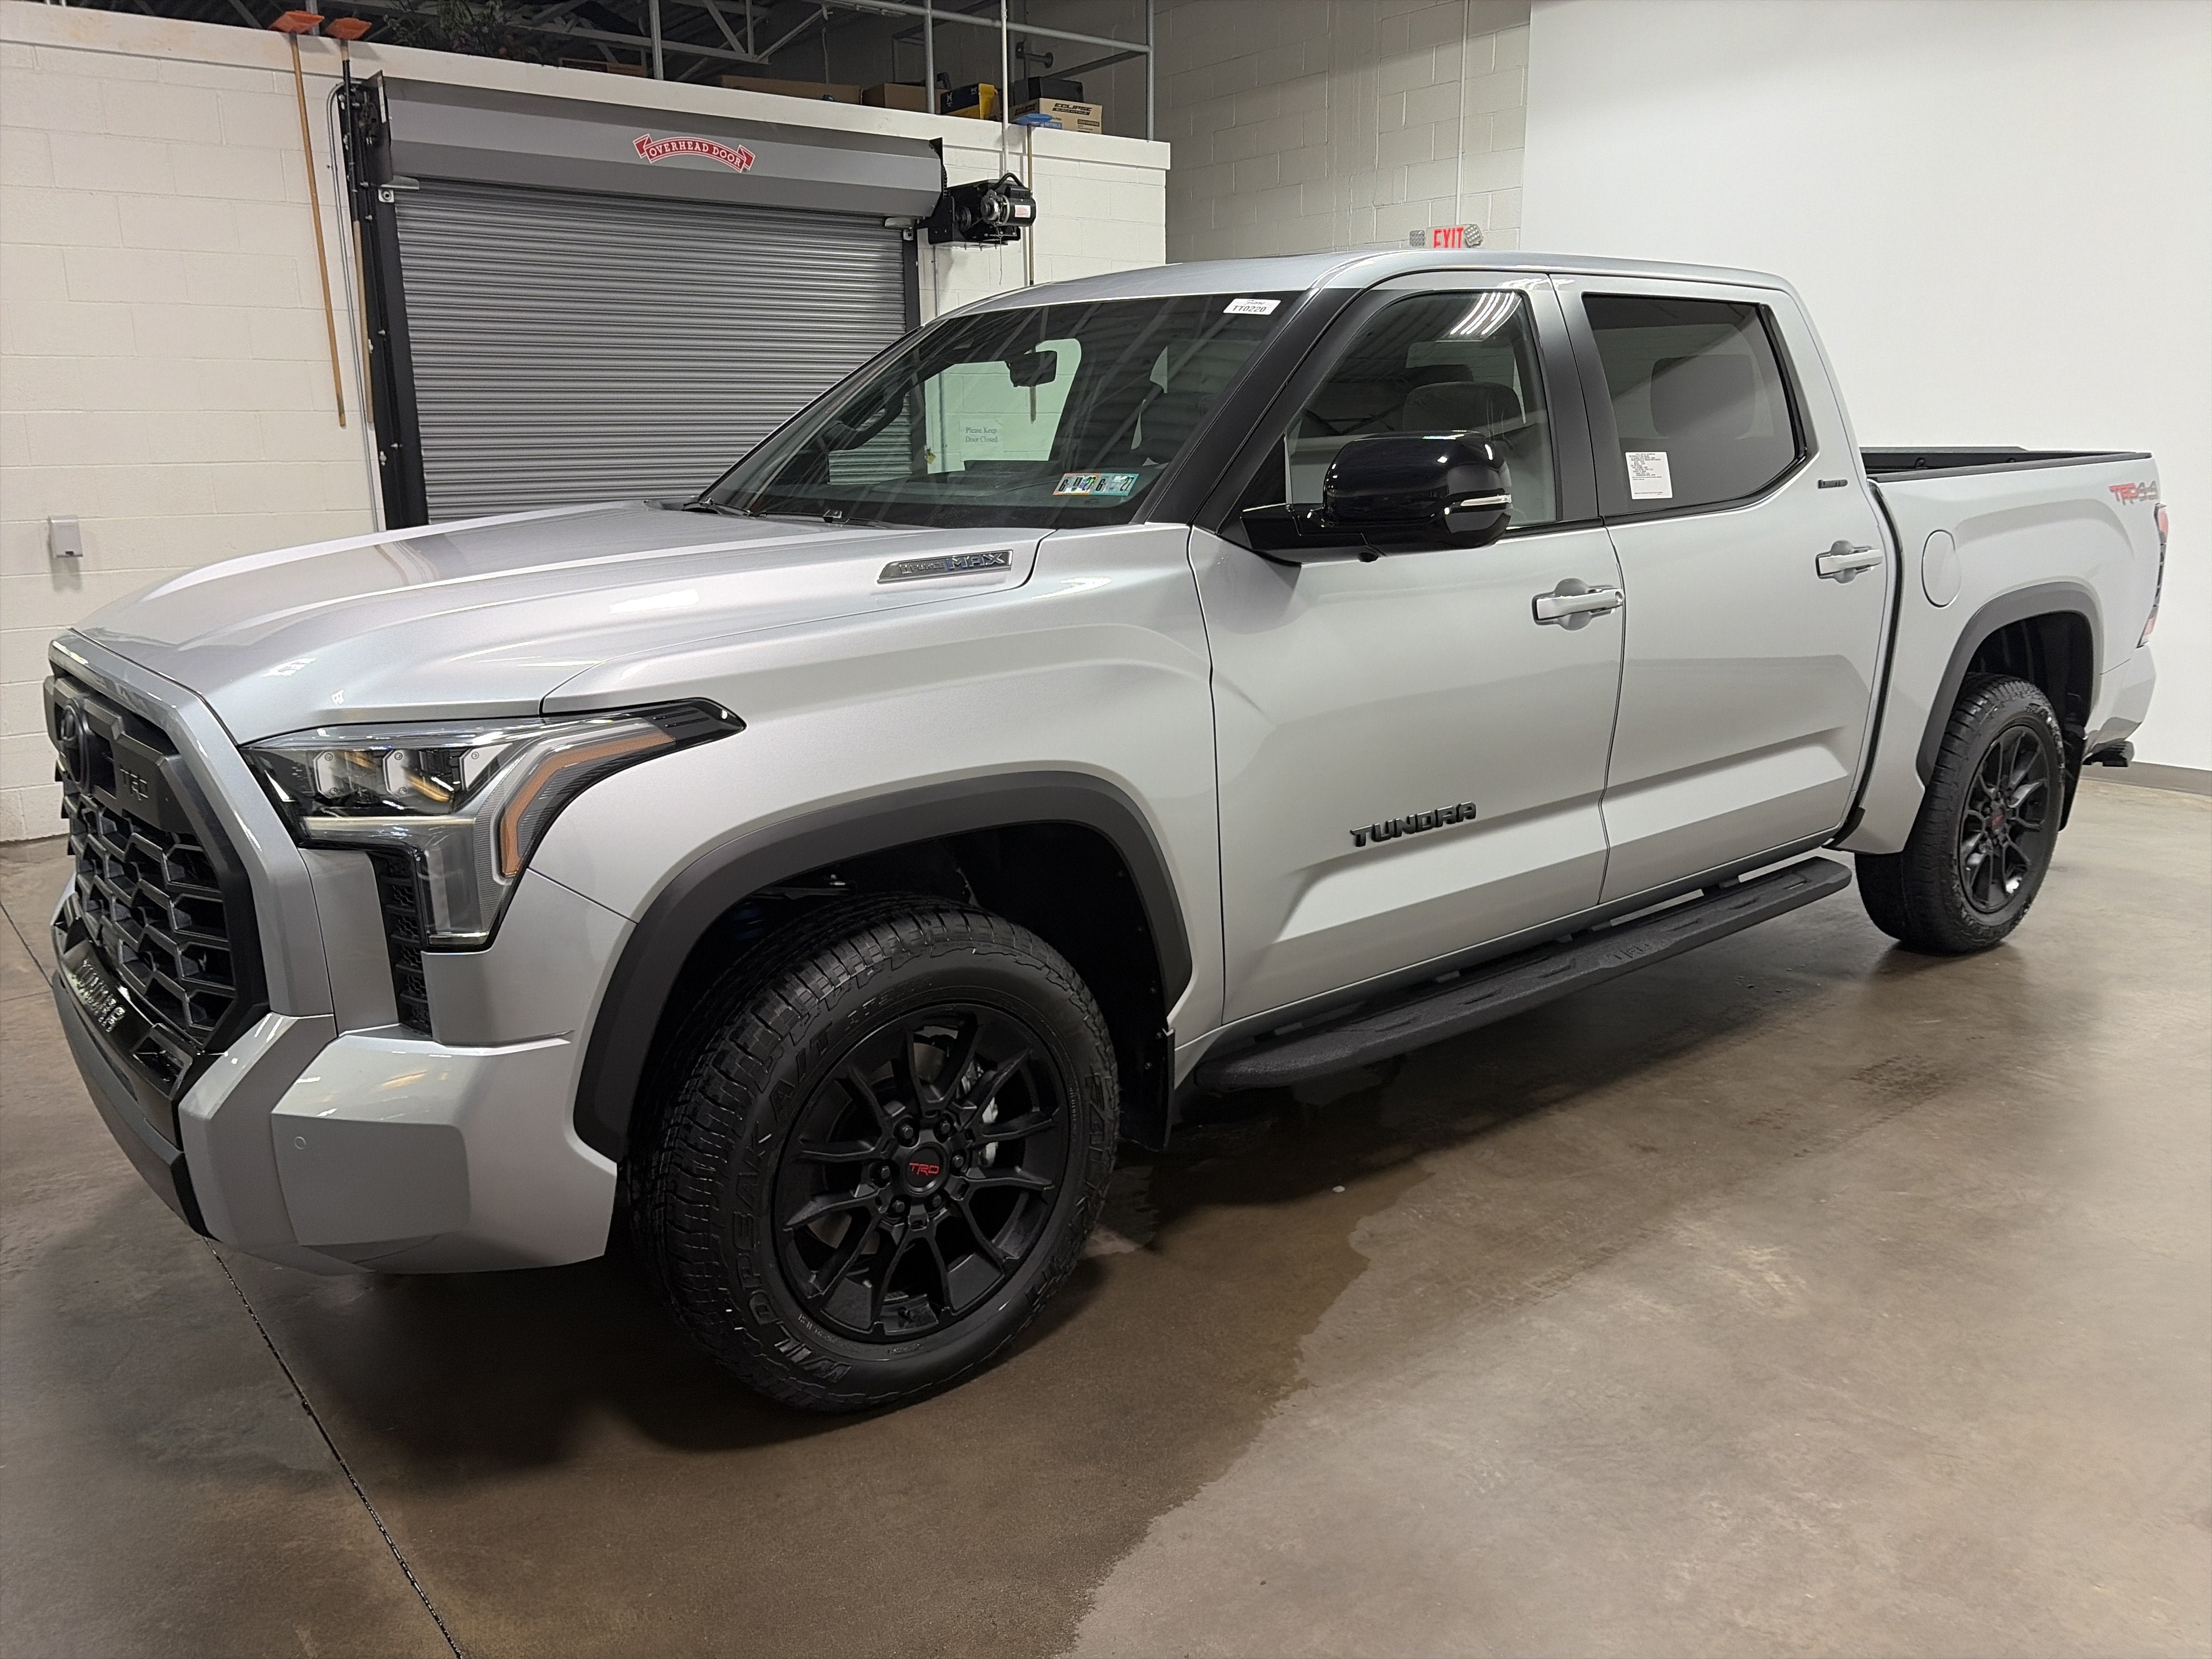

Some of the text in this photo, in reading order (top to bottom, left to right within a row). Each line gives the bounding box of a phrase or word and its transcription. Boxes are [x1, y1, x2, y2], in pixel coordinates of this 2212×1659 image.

[1054, 103, 1092, 112] ECLIPSE
[649, 141, 741, 167] OVERHEAD DOOR
[1433, 227, 1464, 249] EXIT
[1120, 476, 1135, 492] 27
[946, 552, 1005, 571] MAX
[1350, 801, 1476, 848] TUNDRA
[909, 1162, 940, 1176] TRD
